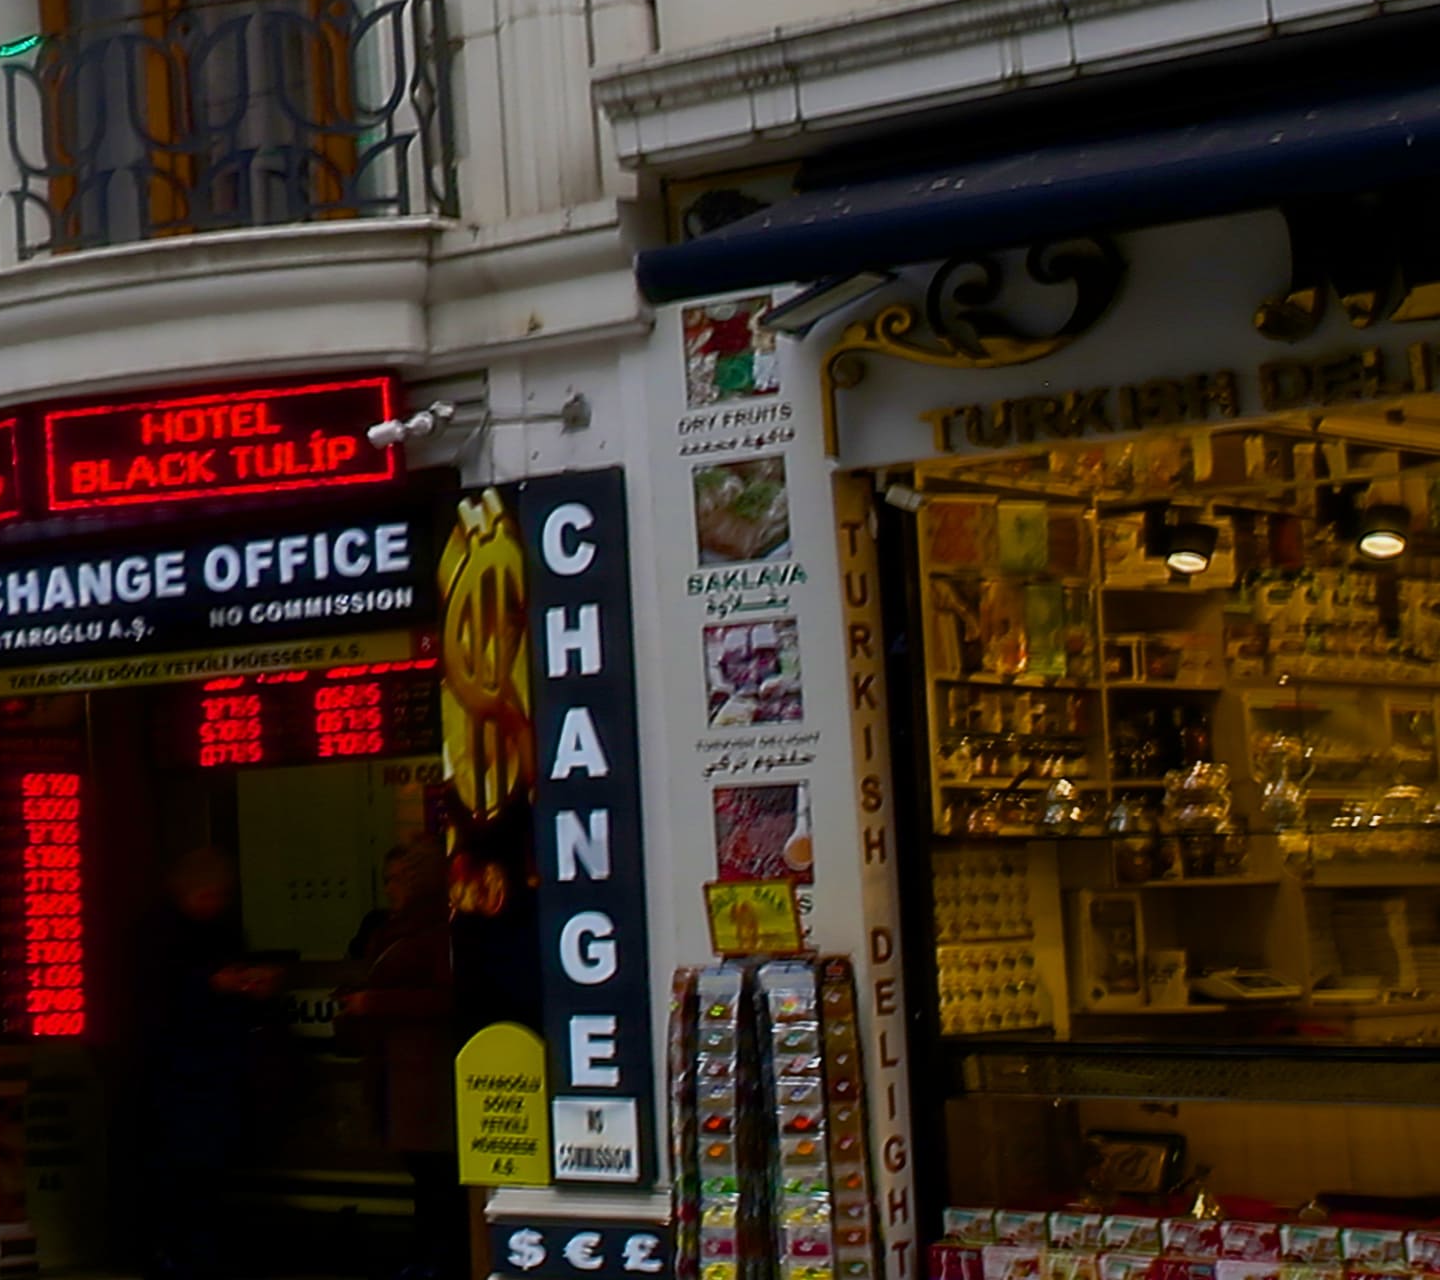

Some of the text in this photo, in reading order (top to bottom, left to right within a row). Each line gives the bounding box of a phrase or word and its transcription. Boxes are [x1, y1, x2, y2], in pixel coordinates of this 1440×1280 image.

[140, 401, 282, 446] HOTEL
[679, 401, 792, 437] DRY FRUITS
[921, 341, 1440, 453] TURKISH DELI
[69, 429, 358, 495] BLACK TULİP
[202, 521, 413, 593] OFFICE
[687, 563, 807, 596] BAKLAVA
[209, 586, 415, 629] NO COMMISSION
[541, 501, 622, 1088] CHANGE
[840, 522, 910, 1278] TURKISH DELIGHT
[506, 1227, 665, 1274] $ € £
